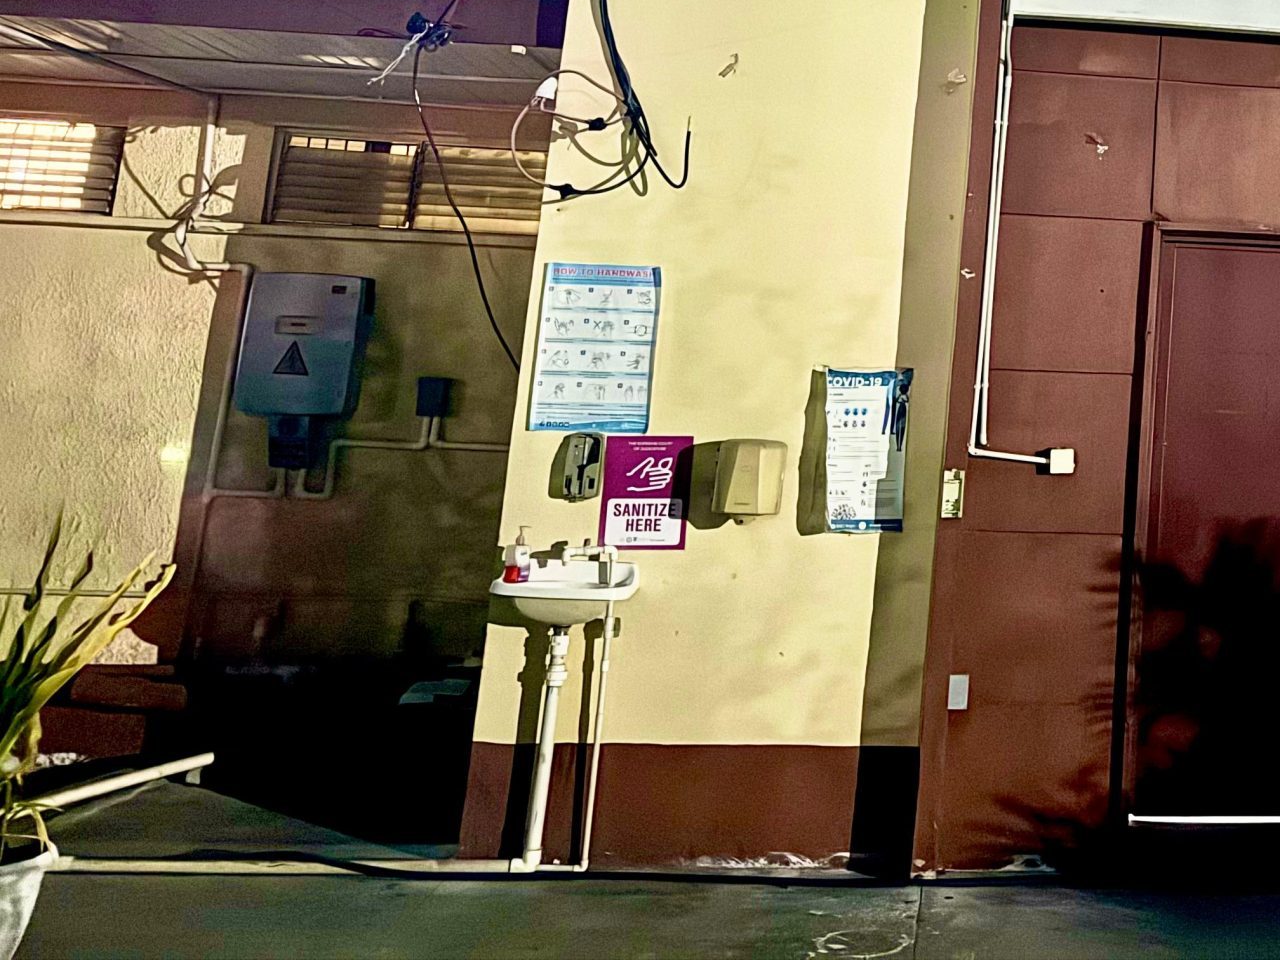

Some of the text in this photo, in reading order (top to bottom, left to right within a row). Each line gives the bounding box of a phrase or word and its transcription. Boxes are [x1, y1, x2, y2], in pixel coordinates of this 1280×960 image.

[553, 267, 576, 275] HOW
[580, 268, 593, 276] TO
[827, 376, 882, 387] COVID-19
[613, 502, 677, 517] SANITIZE
[625, 518, 662, 532] HERE
